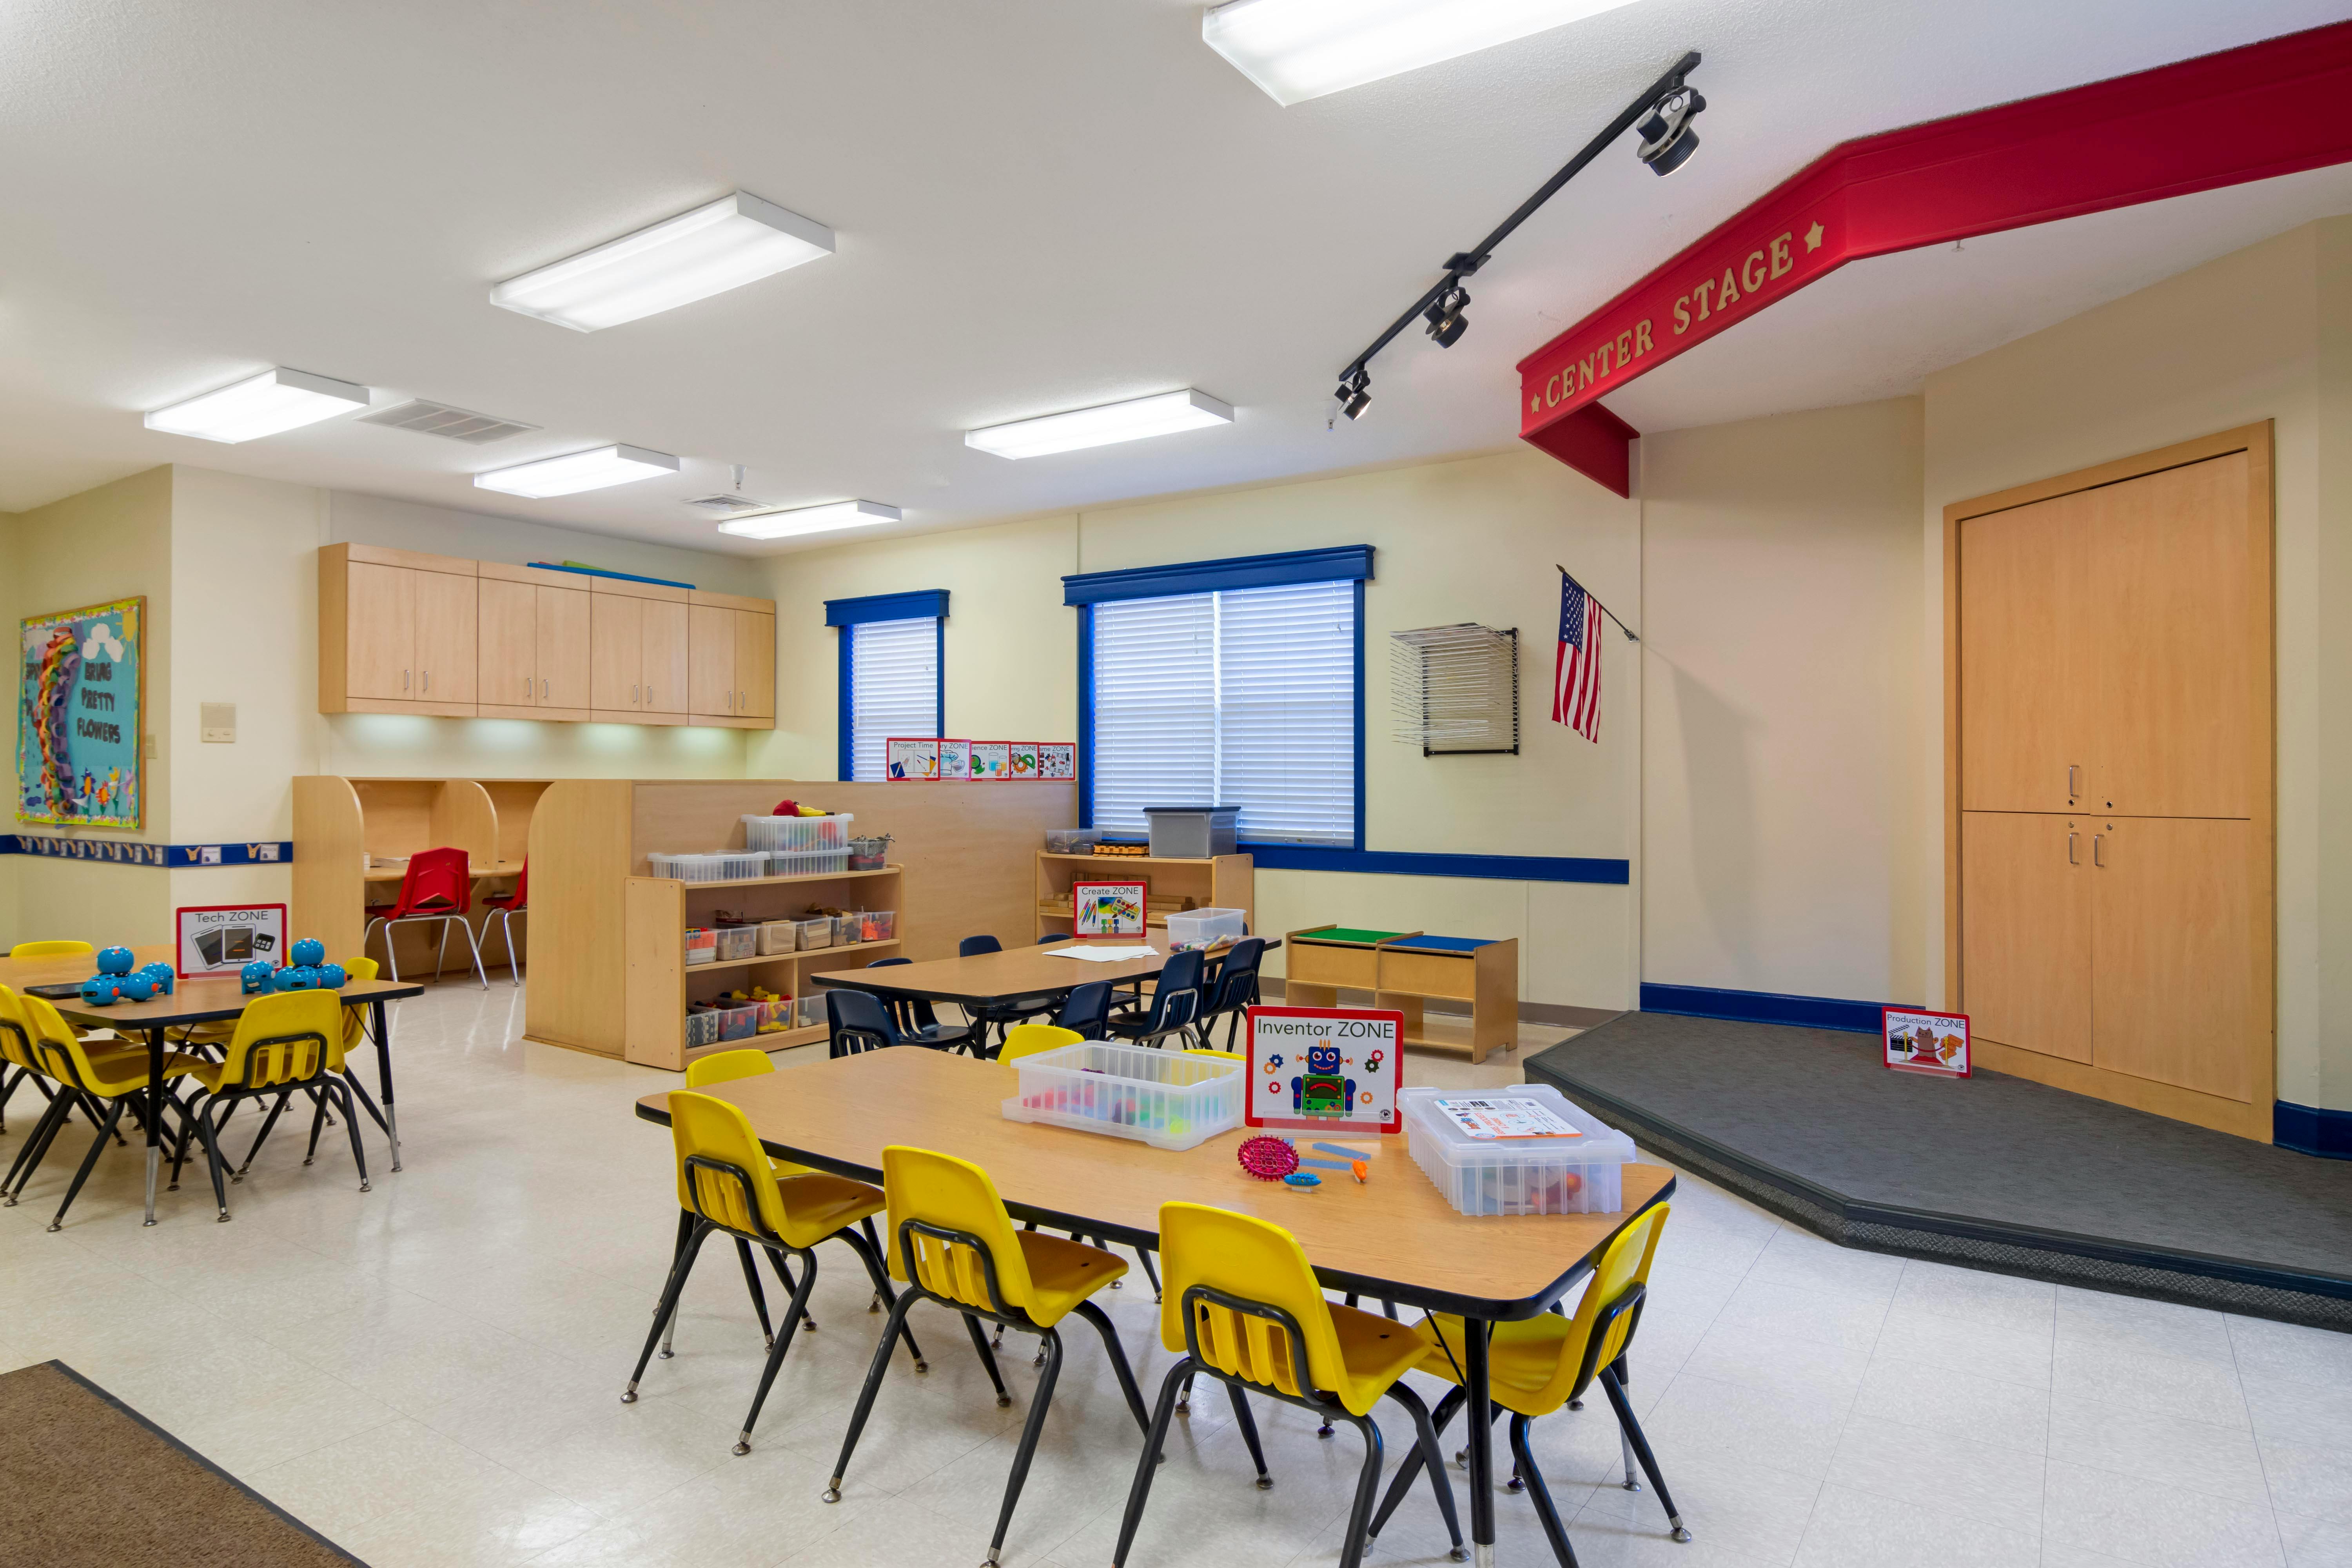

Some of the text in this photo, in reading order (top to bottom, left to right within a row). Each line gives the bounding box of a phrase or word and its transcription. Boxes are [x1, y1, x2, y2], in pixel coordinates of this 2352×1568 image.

[1546, 231, 1794, 408] CENTER STAGE
[85, 662, 112, 682] BRING
[82, 687, 115, 712] PRETTY
[77, 717, 120, 744] FLOWERS
[195, 911, 269, 922] Tech ZONE
[1258, 1018, 1394, 1038] Inventor ZONE
[1887, 1014, 1965, 1029] Production ZONE
